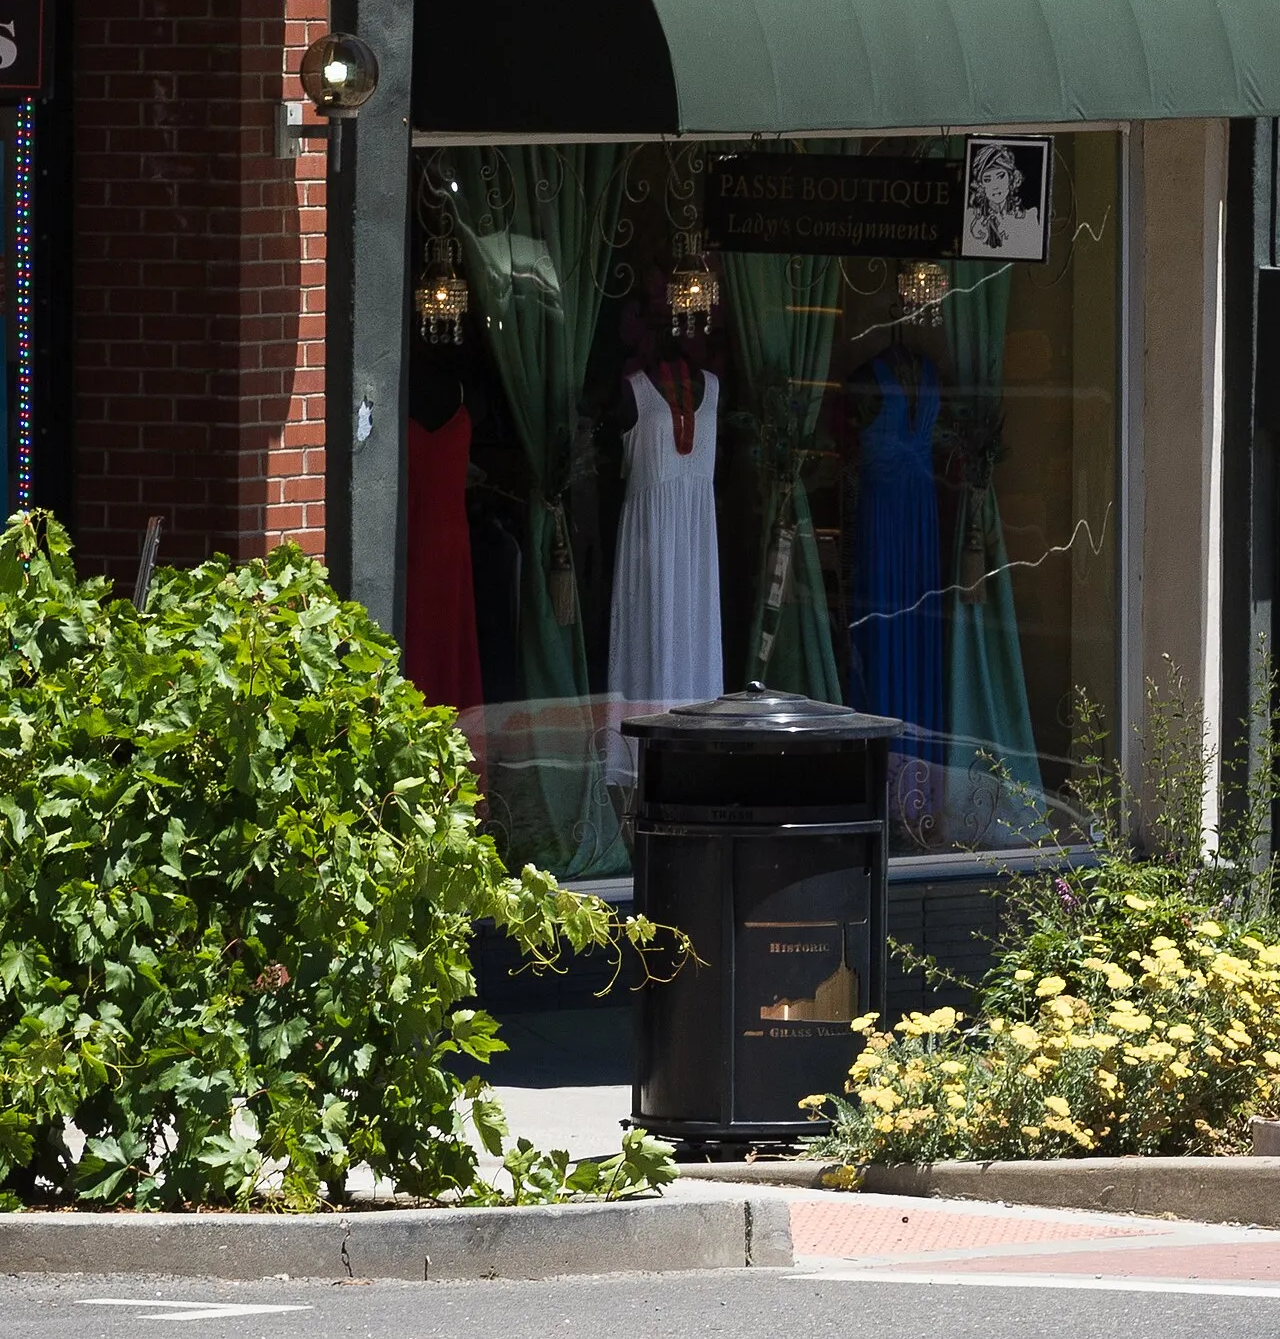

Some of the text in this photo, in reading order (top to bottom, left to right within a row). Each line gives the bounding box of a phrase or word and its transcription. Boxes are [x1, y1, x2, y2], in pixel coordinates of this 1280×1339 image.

[719, 167, 949, 208] PASSÉ BOUTIQUE
[796, 215, 938, 245] Consignments
[769, 943, 830, 954] HISTORIC
[769, 1027, 812, 1038] GRASS
